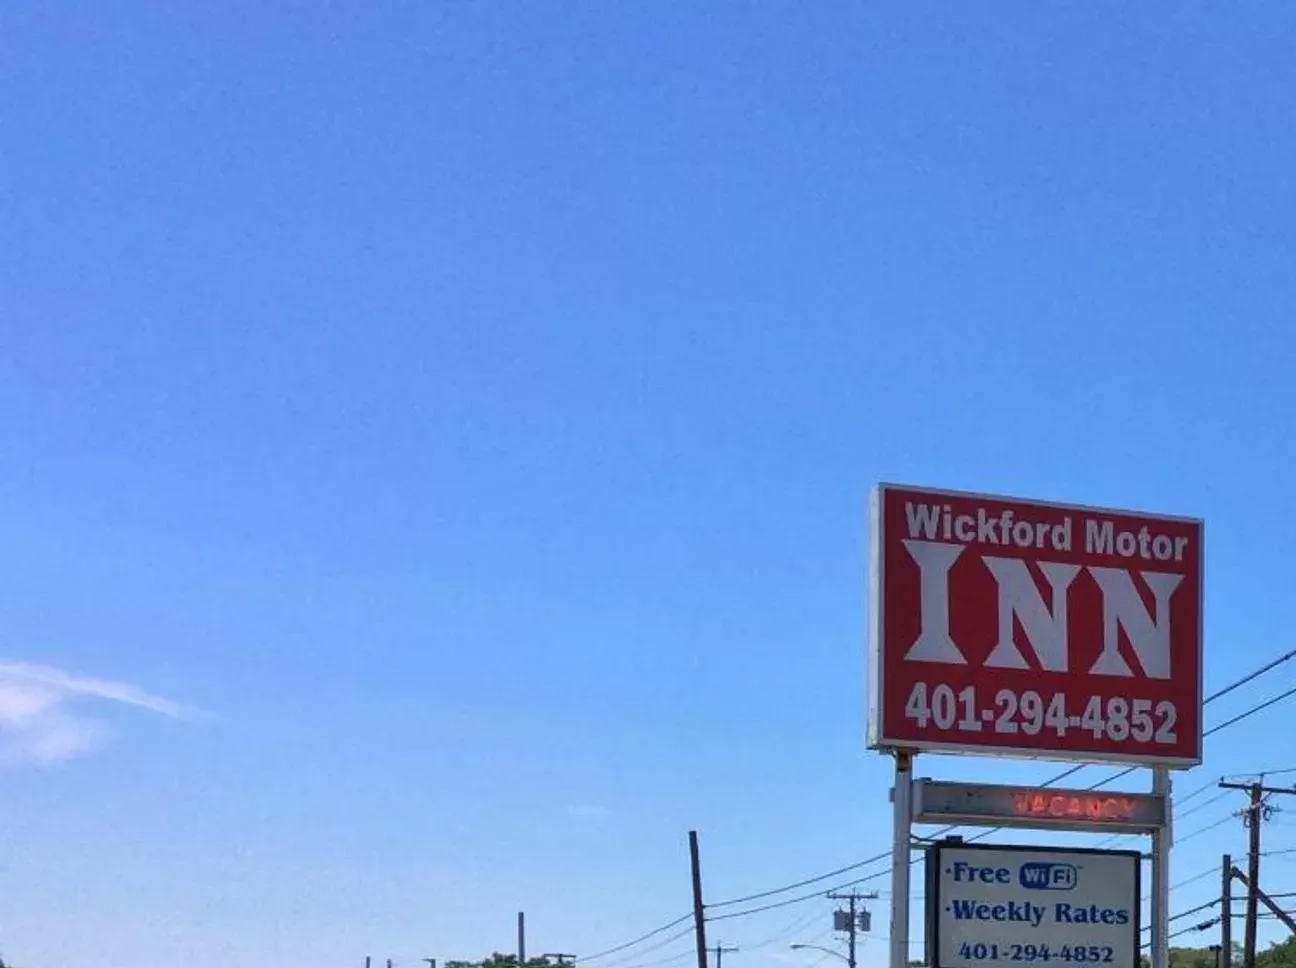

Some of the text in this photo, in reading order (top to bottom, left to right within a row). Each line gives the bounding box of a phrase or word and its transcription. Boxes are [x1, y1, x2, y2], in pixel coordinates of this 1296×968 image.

[905, 502, 1188, 561] Wickford Motor
[903, 539, 1186, 680] INN
[905, 682, 1178, 744] 401-294-4852
[1014, 793, 1136, 818] VACANCY
[953, 862, 1010, 883] Free
[952, 900, 1129, 926] Weekly Rates
[959, 943, 1113, 962] 401-294-4852
